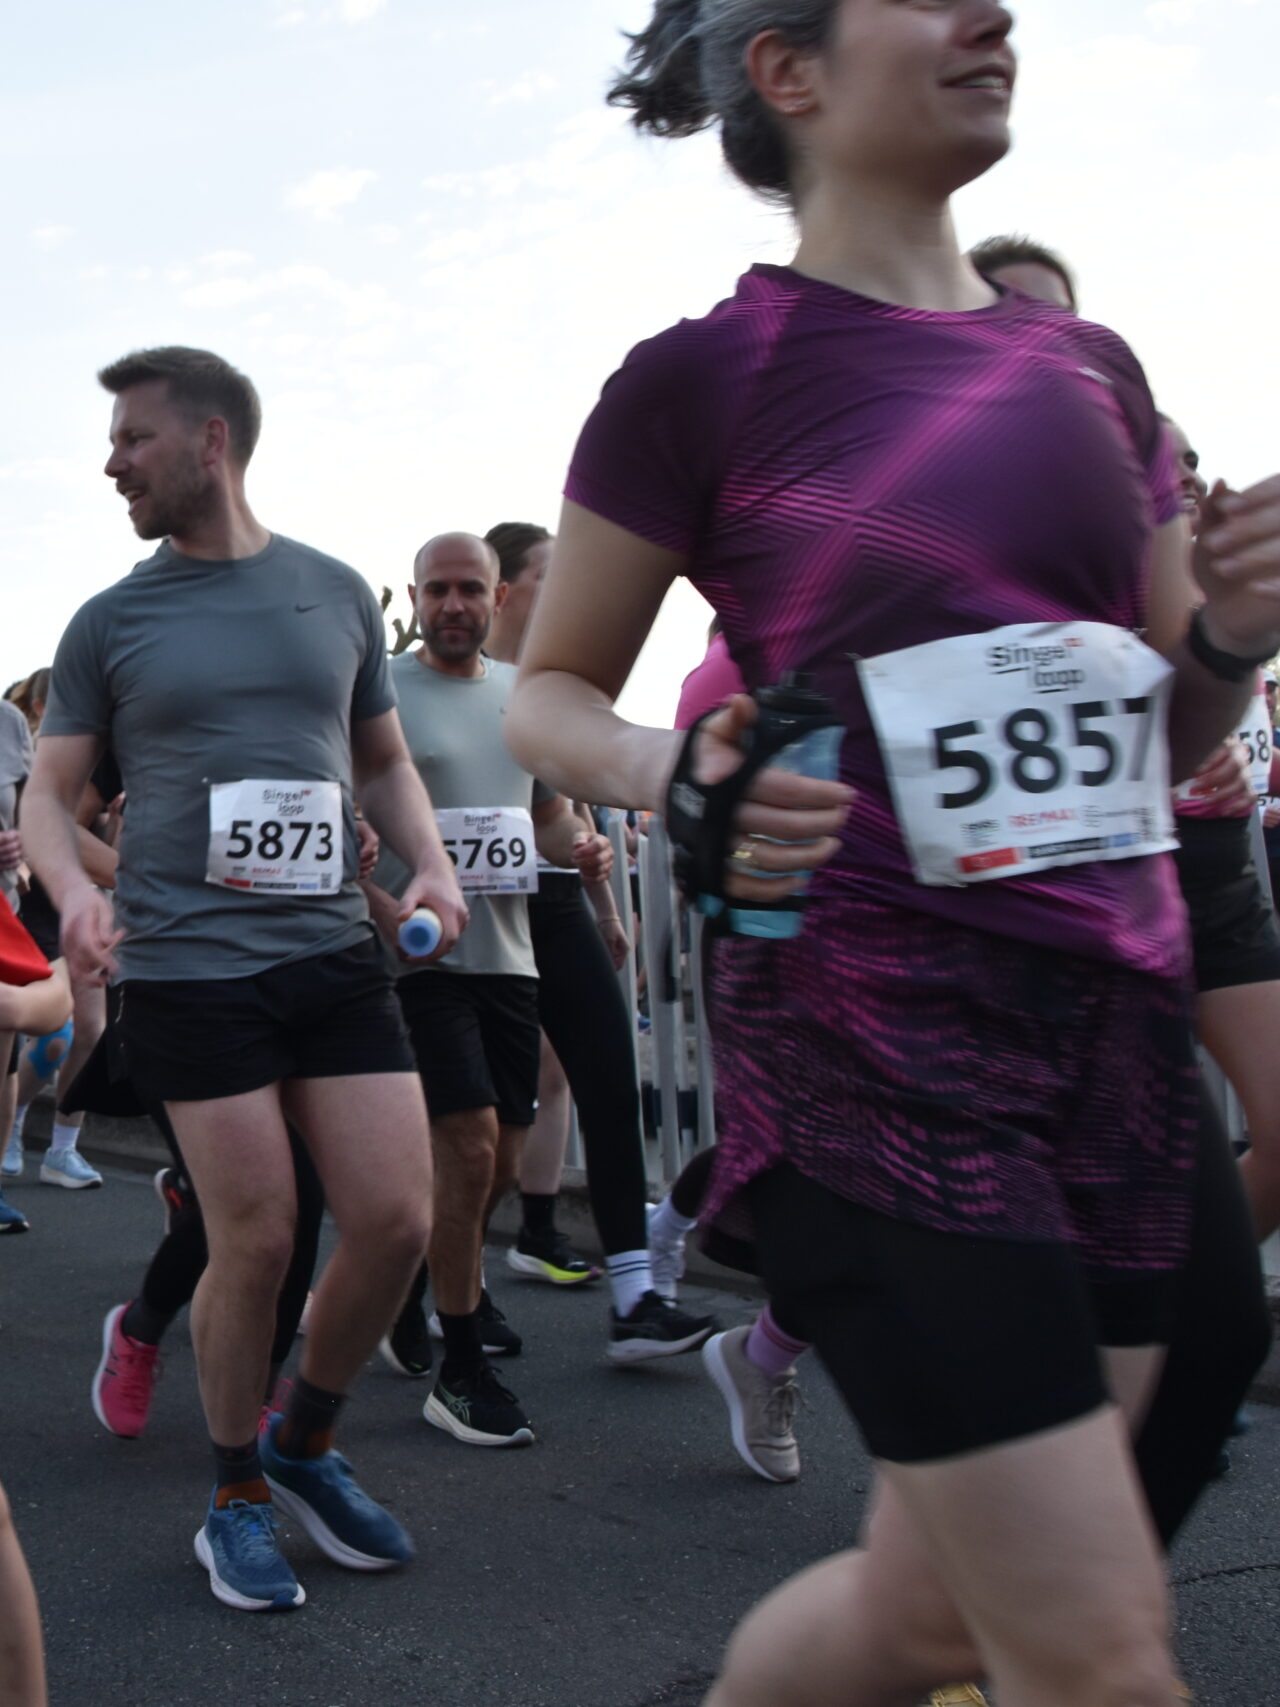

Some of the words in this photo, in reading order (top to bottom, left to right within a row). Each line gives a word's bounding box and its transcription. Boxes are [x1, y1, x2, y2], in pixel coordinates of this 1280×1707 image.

[931, 696, 1156, 809] 5857
[1239, 729, 1269, 763] 58
[226, 820, 333, 861] 5873
[442, 837, 526, 869] 5769
